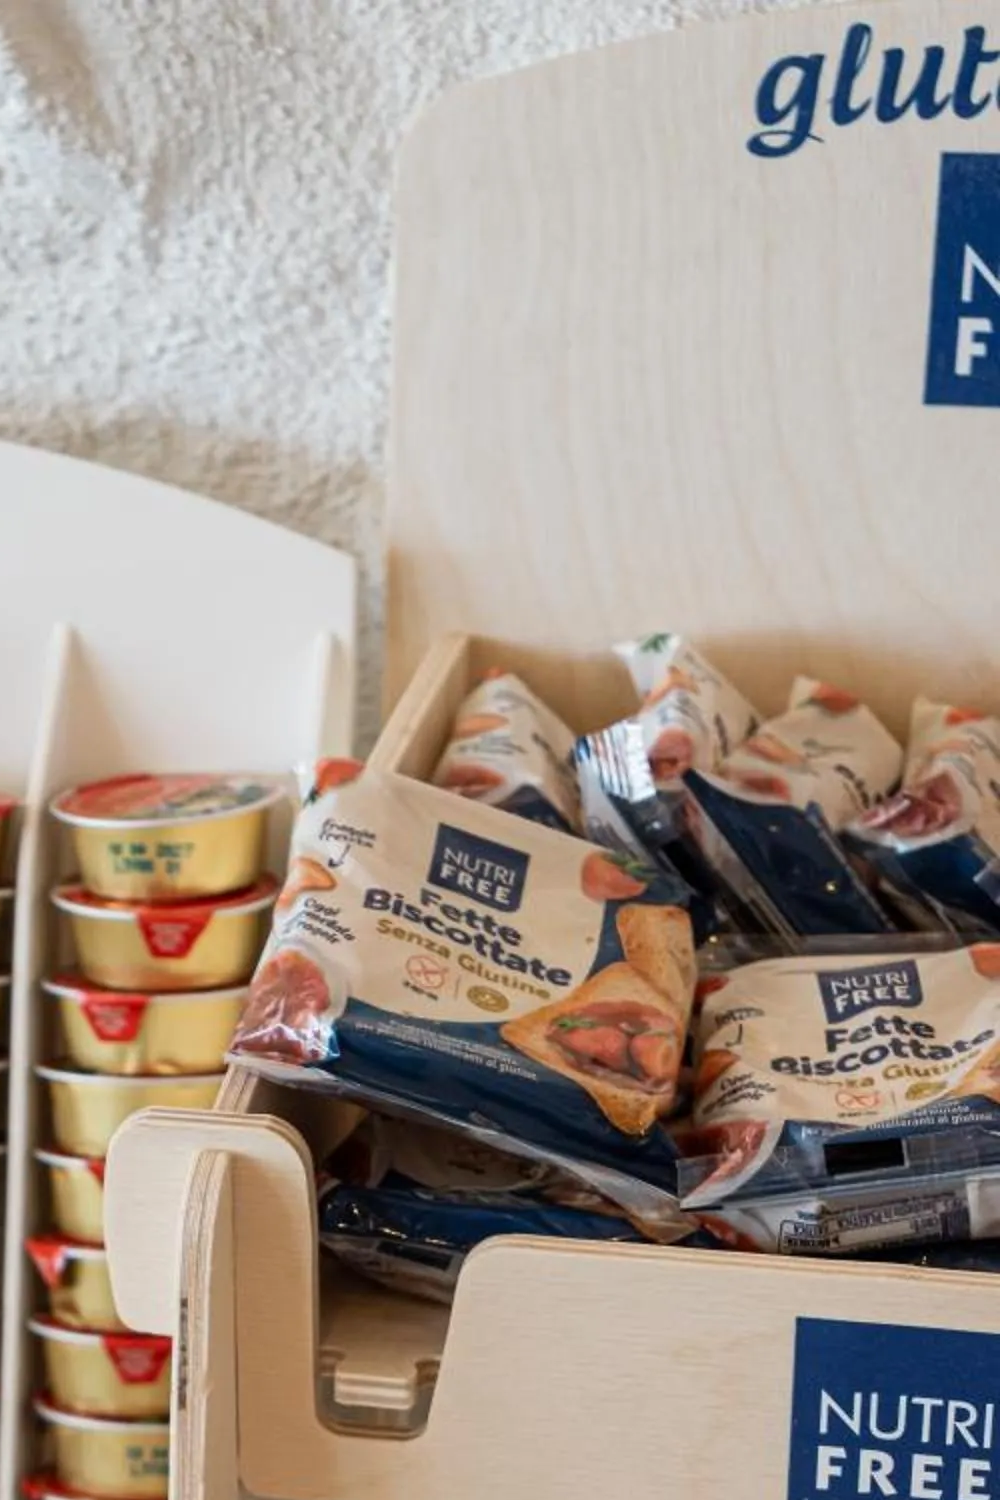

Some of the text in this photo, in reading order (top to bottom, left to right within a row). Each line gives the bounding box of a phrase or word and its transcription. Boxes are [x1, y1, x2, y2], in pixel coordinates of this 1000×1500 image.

[746, 22, 1000, 158] glut
[439, 863, 511, 905] FREE
[443, 847, 517, 886] NUTRI
[362, 888, 573, 987] Biscottate
[420, 887, 522, 947] Fette
[375, 918, 451, 959] Senza
[457, 953, 552, 1000] Glutine
[831, 971, 909, 997] NUTRI
[834, 985, 912, 1016] FREE
[770, 1028, 996, 1077] Biscottate
[825, 1015, 936, 1053] Fette
[818, 1389, 994, 1450] NUTRI
